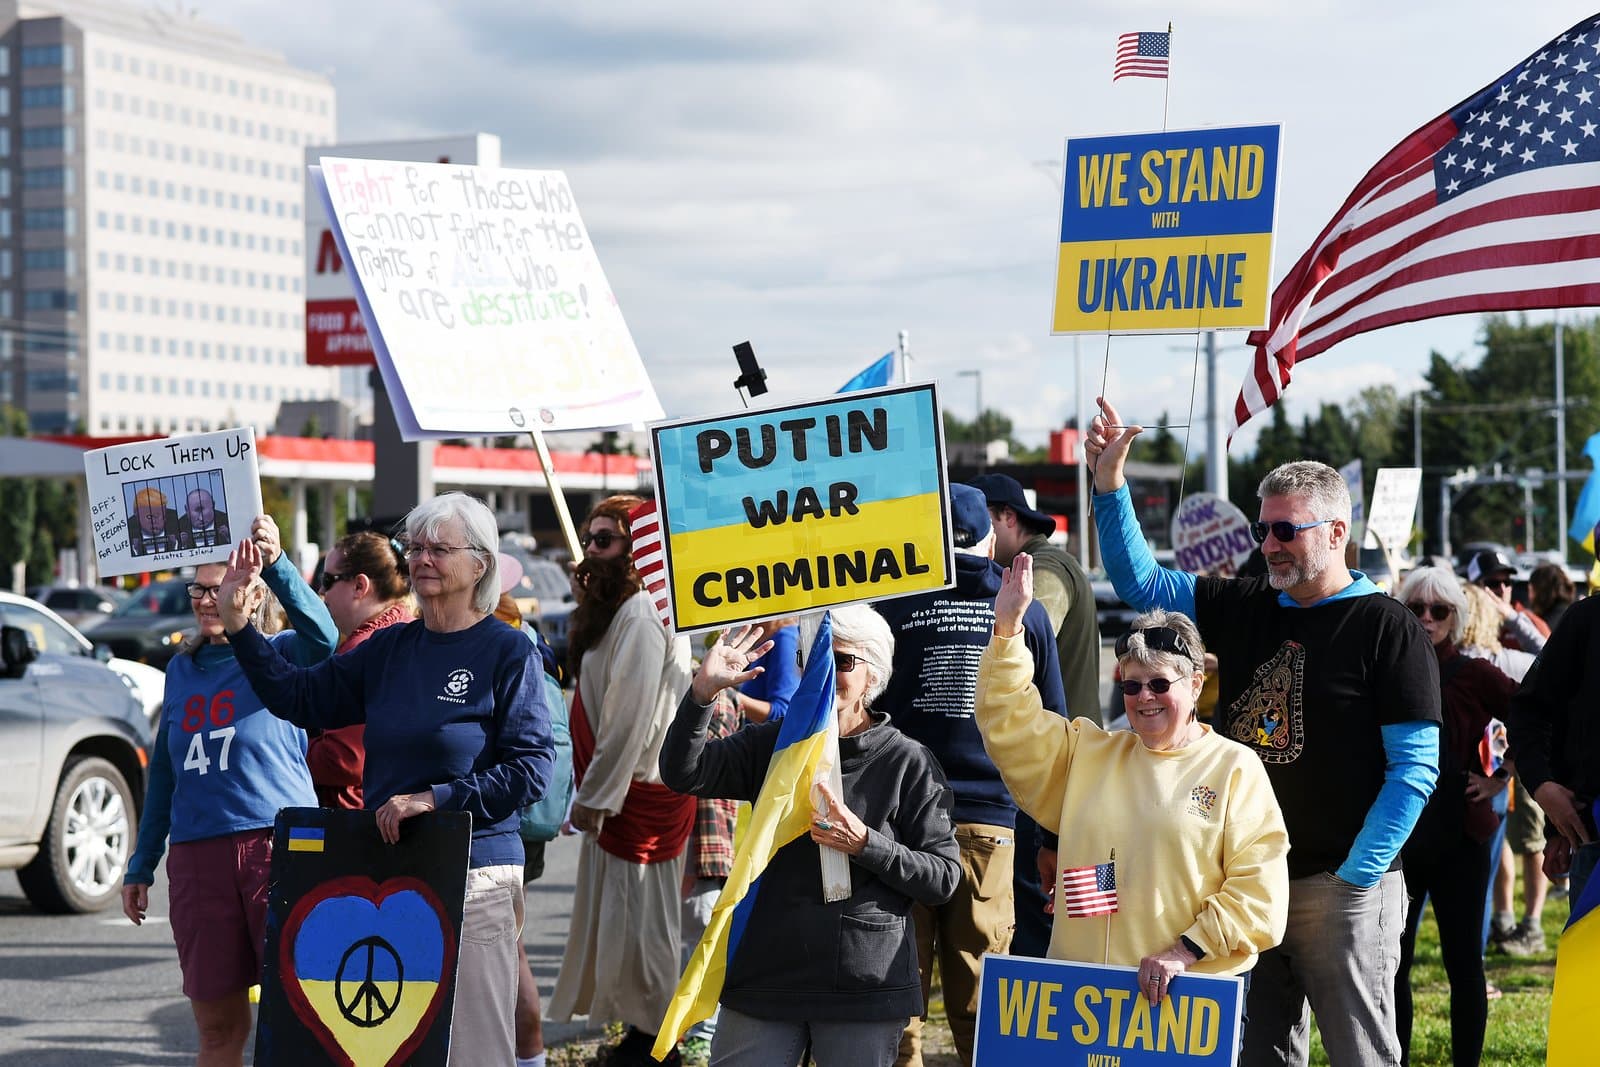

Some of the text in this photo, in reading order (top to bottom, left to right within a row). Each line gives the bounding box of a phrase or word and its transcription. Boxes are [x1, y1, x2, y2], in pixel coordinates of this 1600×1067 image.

[333, 164, 394, 214] Fight
[406, 166, 439, 205] for
[1078, 144, 1265, 208] WE STAND
[503, 218, 532, 254] for
[535, 218, 583, 252] the
[1152, 212, 1180, 228] WITH
[357, 245, 414, 292] rights
[427, 252, 440, 284] of
[1078, 252, 1246, 313] UKRAINE
[398, 288, 456, 329] are
[460, 284, 591, 326] destitute!
[104, 453, 155, 476] LOCK
[165, 443, 214, 464] THEM
[696, 408, 888, 474] PUTIN
[92, 496, 116, 515] BFF's
[742, 482, 860, 528] WAR
[100, 520, 128, 542] FELONS
[98, 547, 112, 559] FOR
[153, 548, 214, 561] Alcatraz Island
[692, 542, 930, 607] CRIMINAL
[902, 621, 913, 630] and
[926, 617, 941, 626] play
[957, 616, 984, 624] brought
[938, 608, 974, 616] magnitude
[950, 600, 990, 608] anniversary
[182, 690, 235, 732] 86
[183, 726, 236, 775] 47
[998, 978, 1220, 1056] WE STAND
